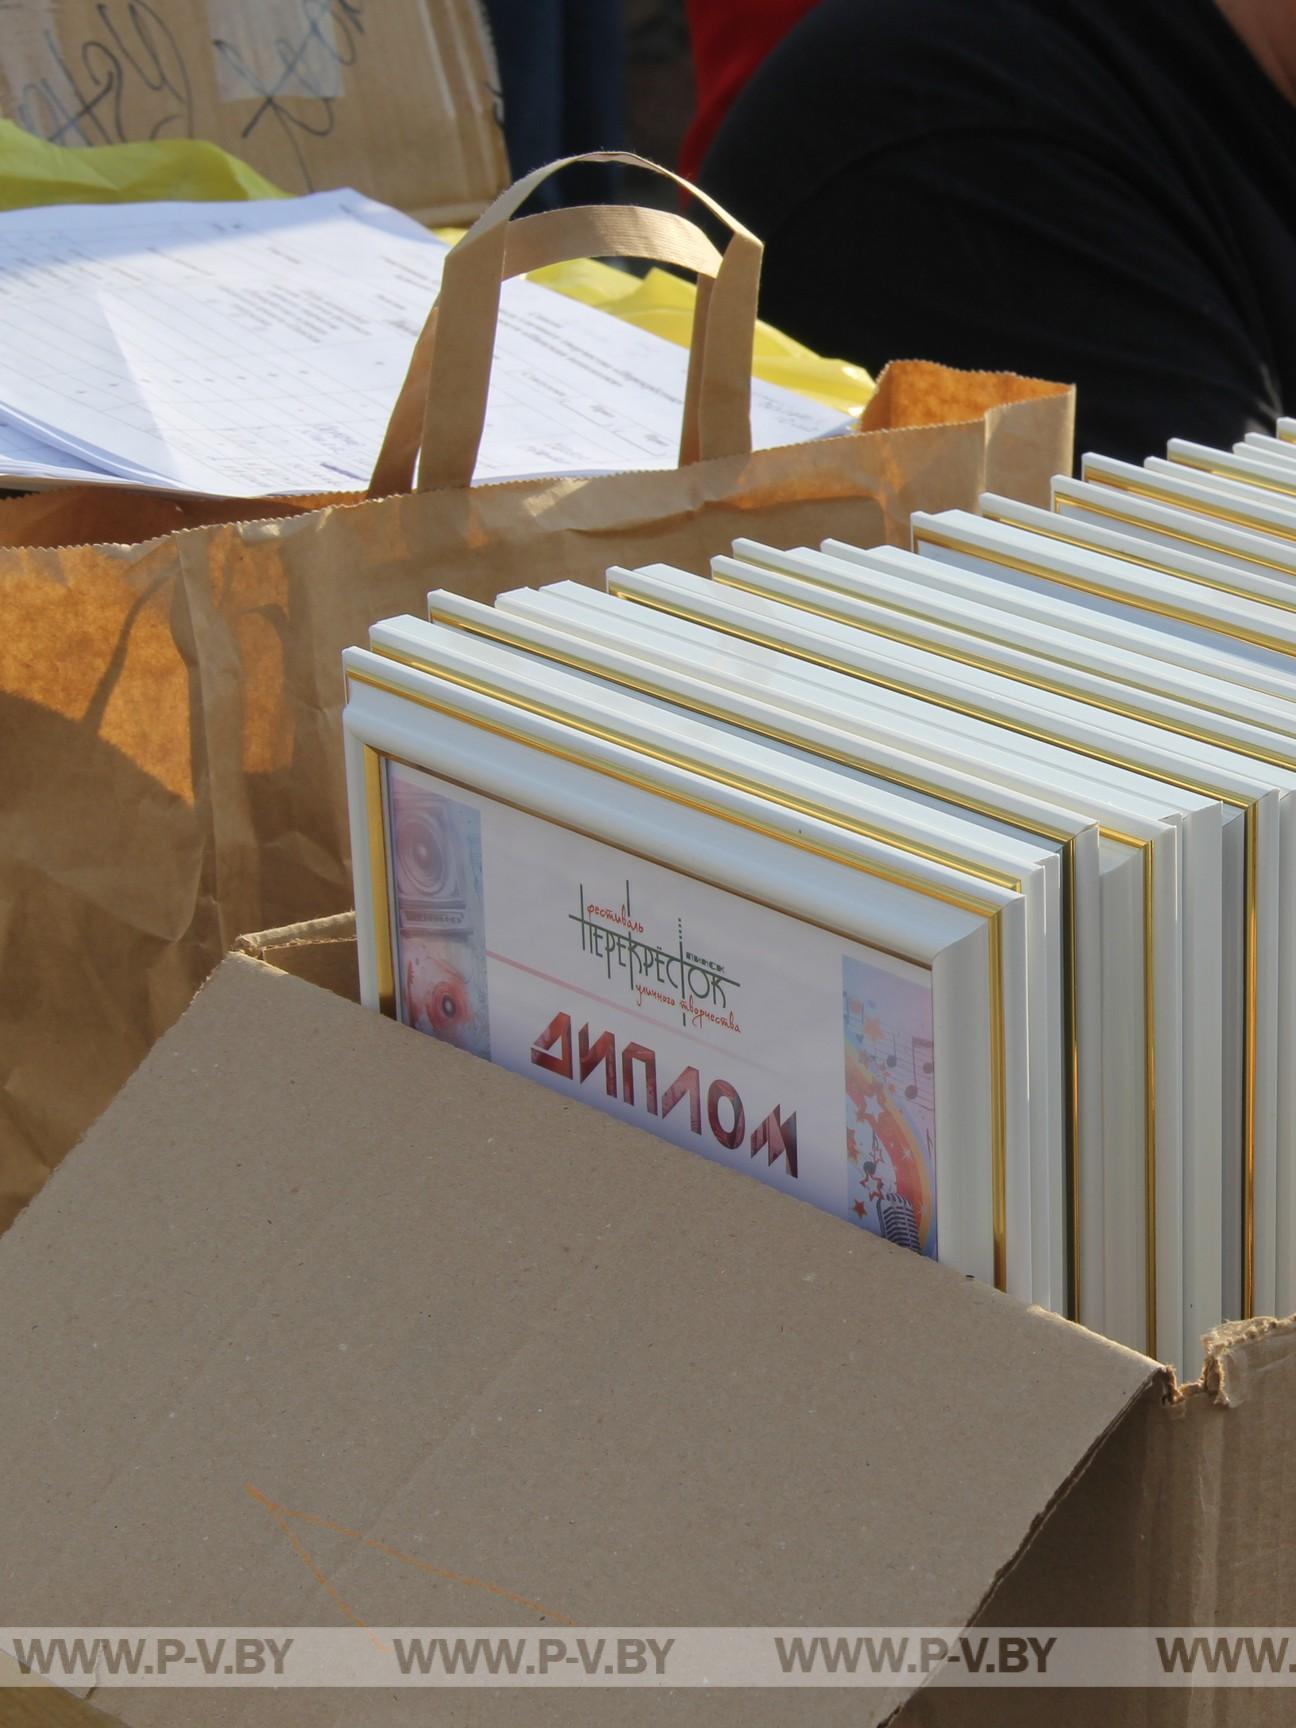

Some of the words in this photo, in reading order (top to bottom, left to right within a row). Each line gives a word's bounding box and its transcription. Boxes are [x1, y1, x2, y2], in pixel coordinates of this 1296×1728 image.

[586, 902, 645, 934] фестиваль
[635, 983, 676, 1007] уличного
[679, 995, 742, 1034] творчества
[530, 1011, 798, 1178] ДИПЛОМ
